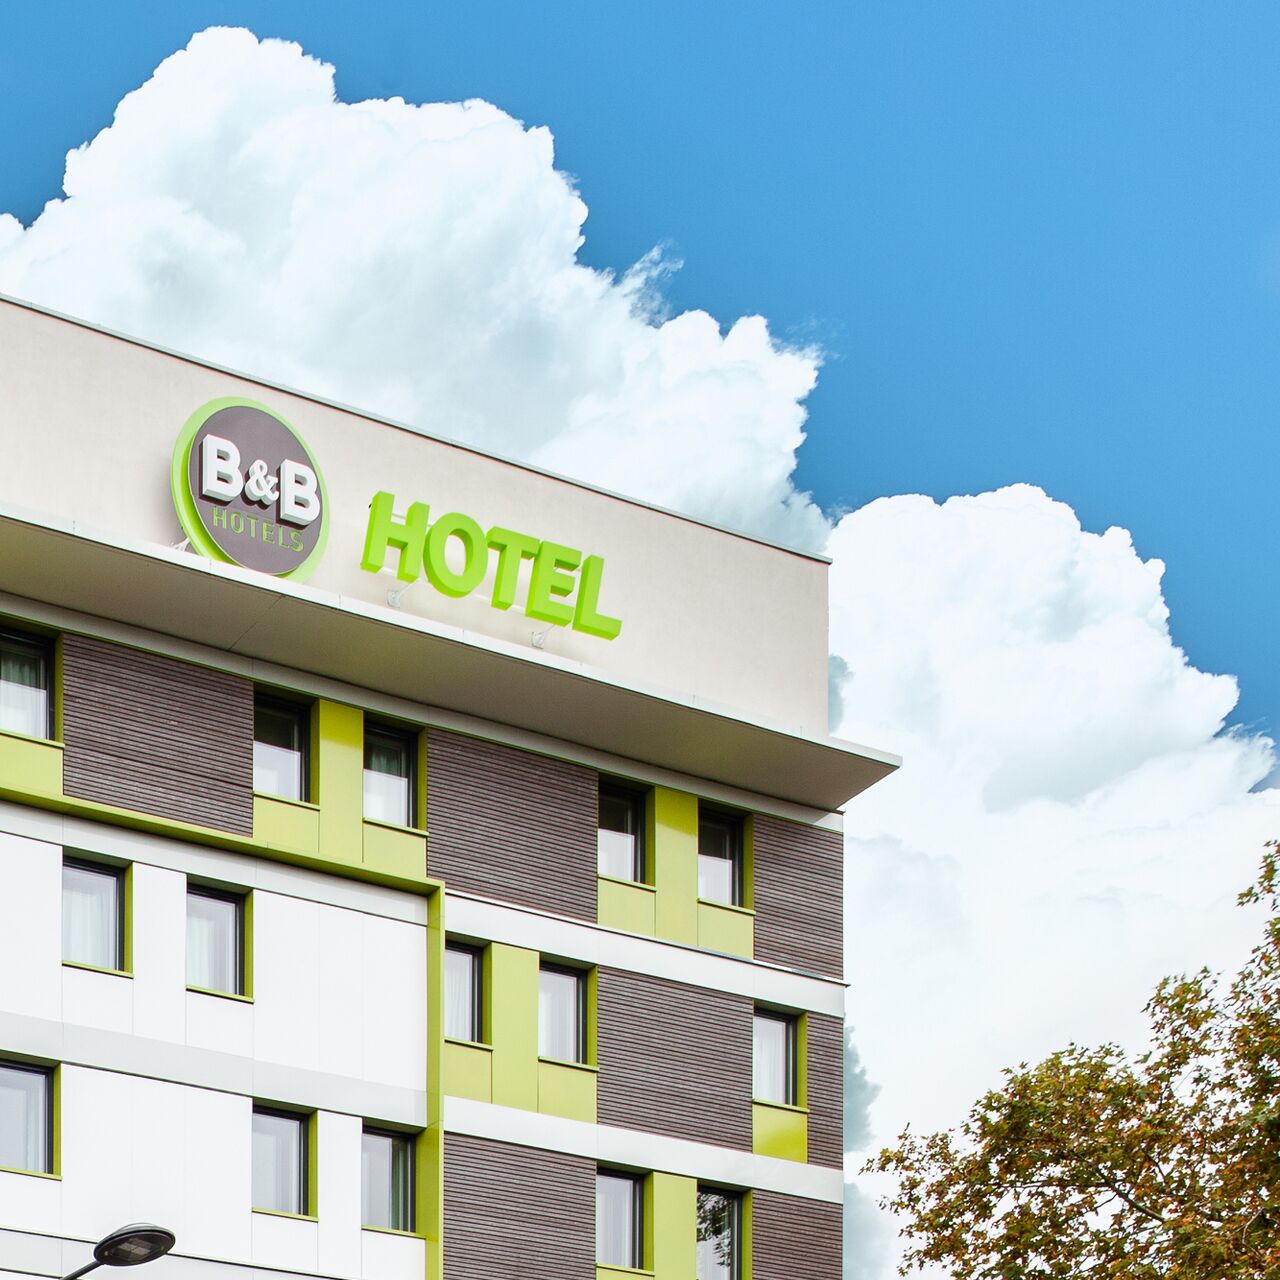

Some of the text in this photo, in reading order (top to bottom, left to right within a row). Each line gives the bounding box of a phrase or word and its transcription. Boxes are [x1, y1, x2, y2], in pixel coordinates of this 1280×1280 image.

[201, 434, 321, 527] B&B
[212, 505, 305, 554] HOTELS
[360, 490, 623, 641] HOTEL
